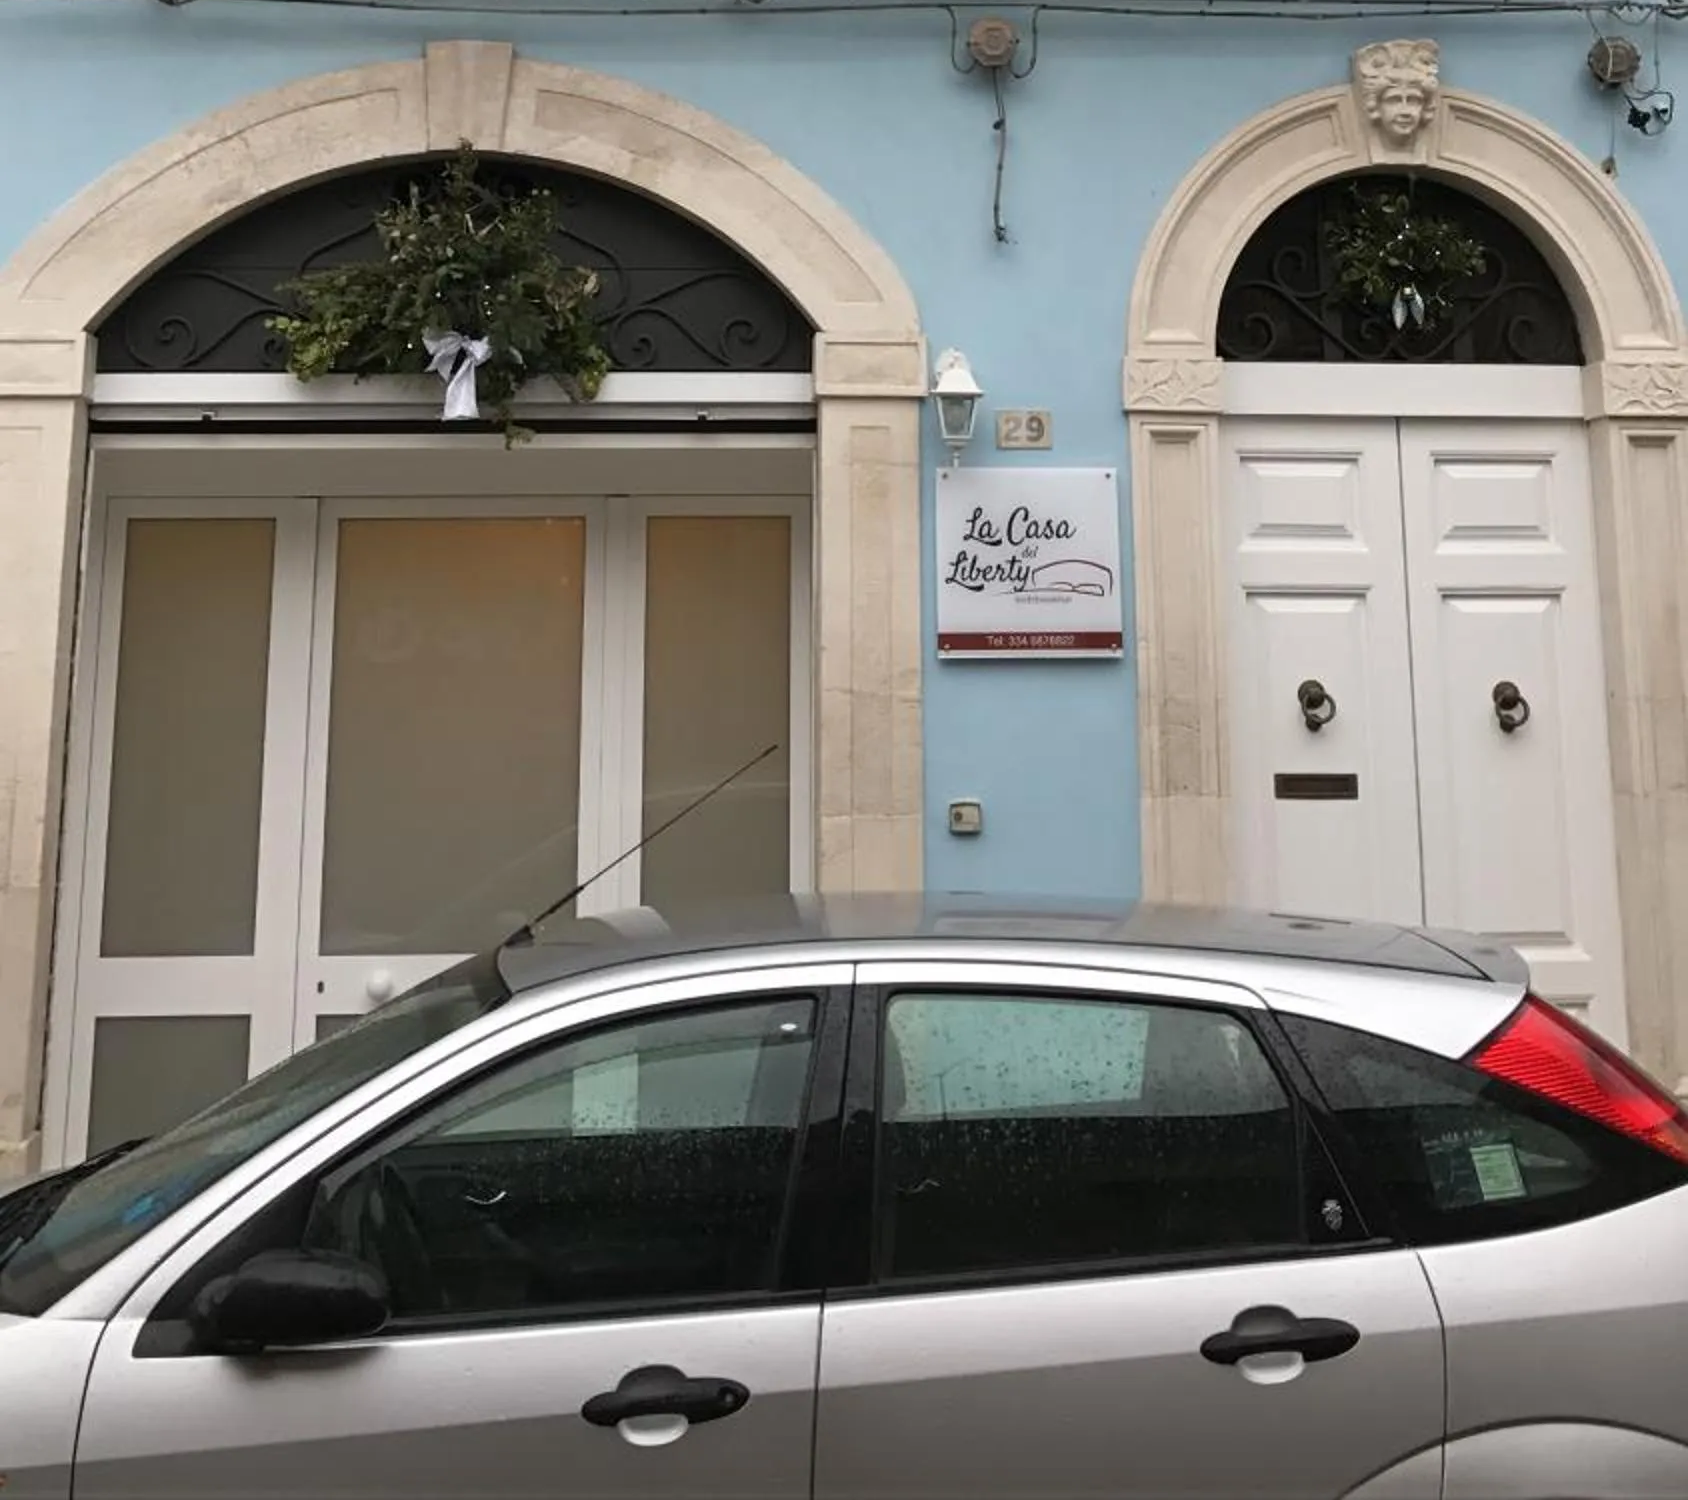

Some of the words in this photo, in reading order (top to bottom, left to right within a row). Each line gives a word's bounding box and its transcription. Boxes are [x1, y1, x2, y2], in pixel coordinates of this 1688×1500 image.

[1004, 415, 1044, 442] 29
[963, 506, 1002, 546] La
[1007, 506, 1077, 546] Casa
[1021, 545, 1039, 558] del
[944, 550, 1031, 592] Liberty
